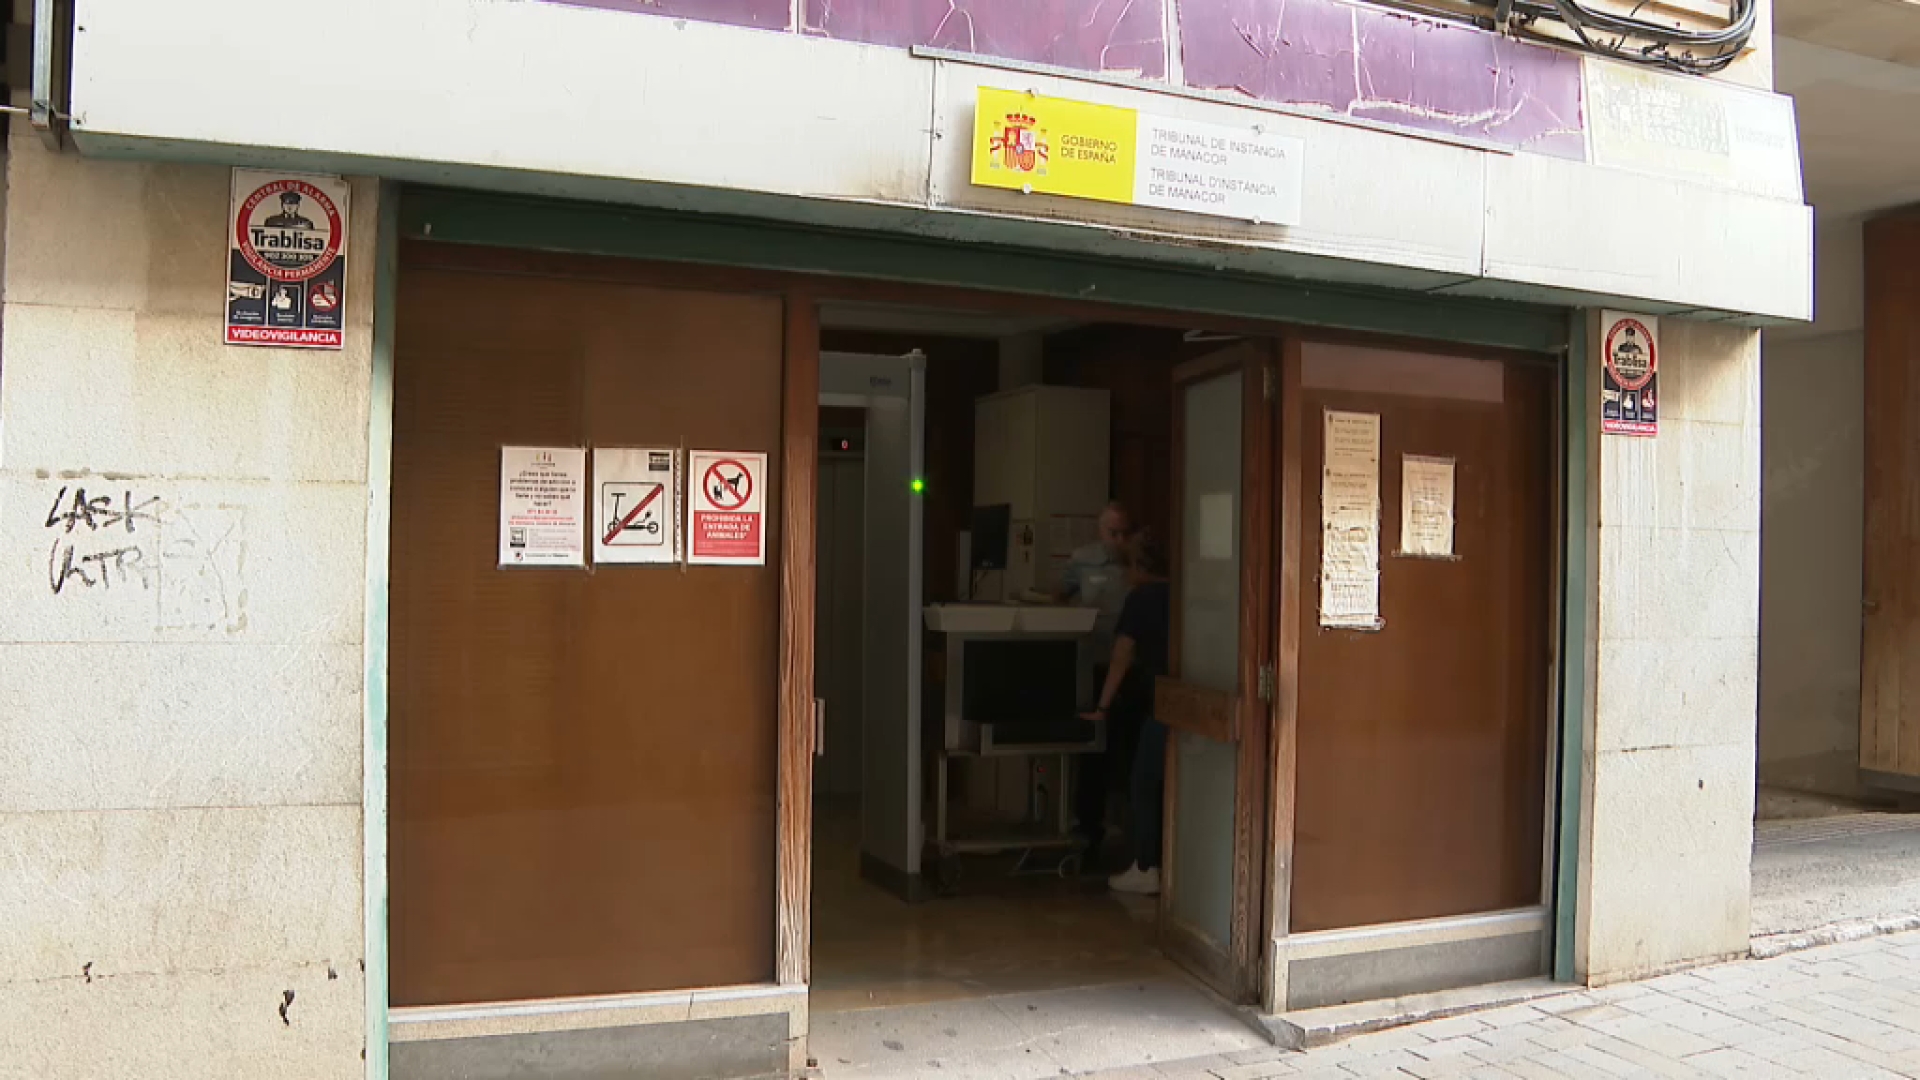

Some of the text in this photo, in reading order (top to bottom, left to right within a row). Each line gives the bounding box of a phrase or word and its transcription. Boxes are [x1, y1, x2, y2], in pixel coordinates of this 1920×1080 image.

[1061, 134, 1118, 152] GOBIERNO
[1152, 128, 1286, 159] TRIBUNAL DE INSTANCIA
[1061, 146, 1116, 165] DE ESPAÑA
[1151, 143, 1227, 165] DE MANACOR
[1150, 167, 1206, 187] TRIBUNAL
[245, 182, 285, 210] CENTRAL
[303, 183, 335, 217] ALARMA
[1149, 183, 1226, 204] DE MANACOR
[251, 229, 325, 249] Trablisa
[241, 240, 336, 279] VIGILANCIA PERMANENTE
[231, 327, 338, 344] VIDEOVIGILANCIA
[45, 485, 160, 533] LASK
[700, 513, 753, 522] PROHIBIDA LA
[702, 522, 751, 532] ENTRADA DE
